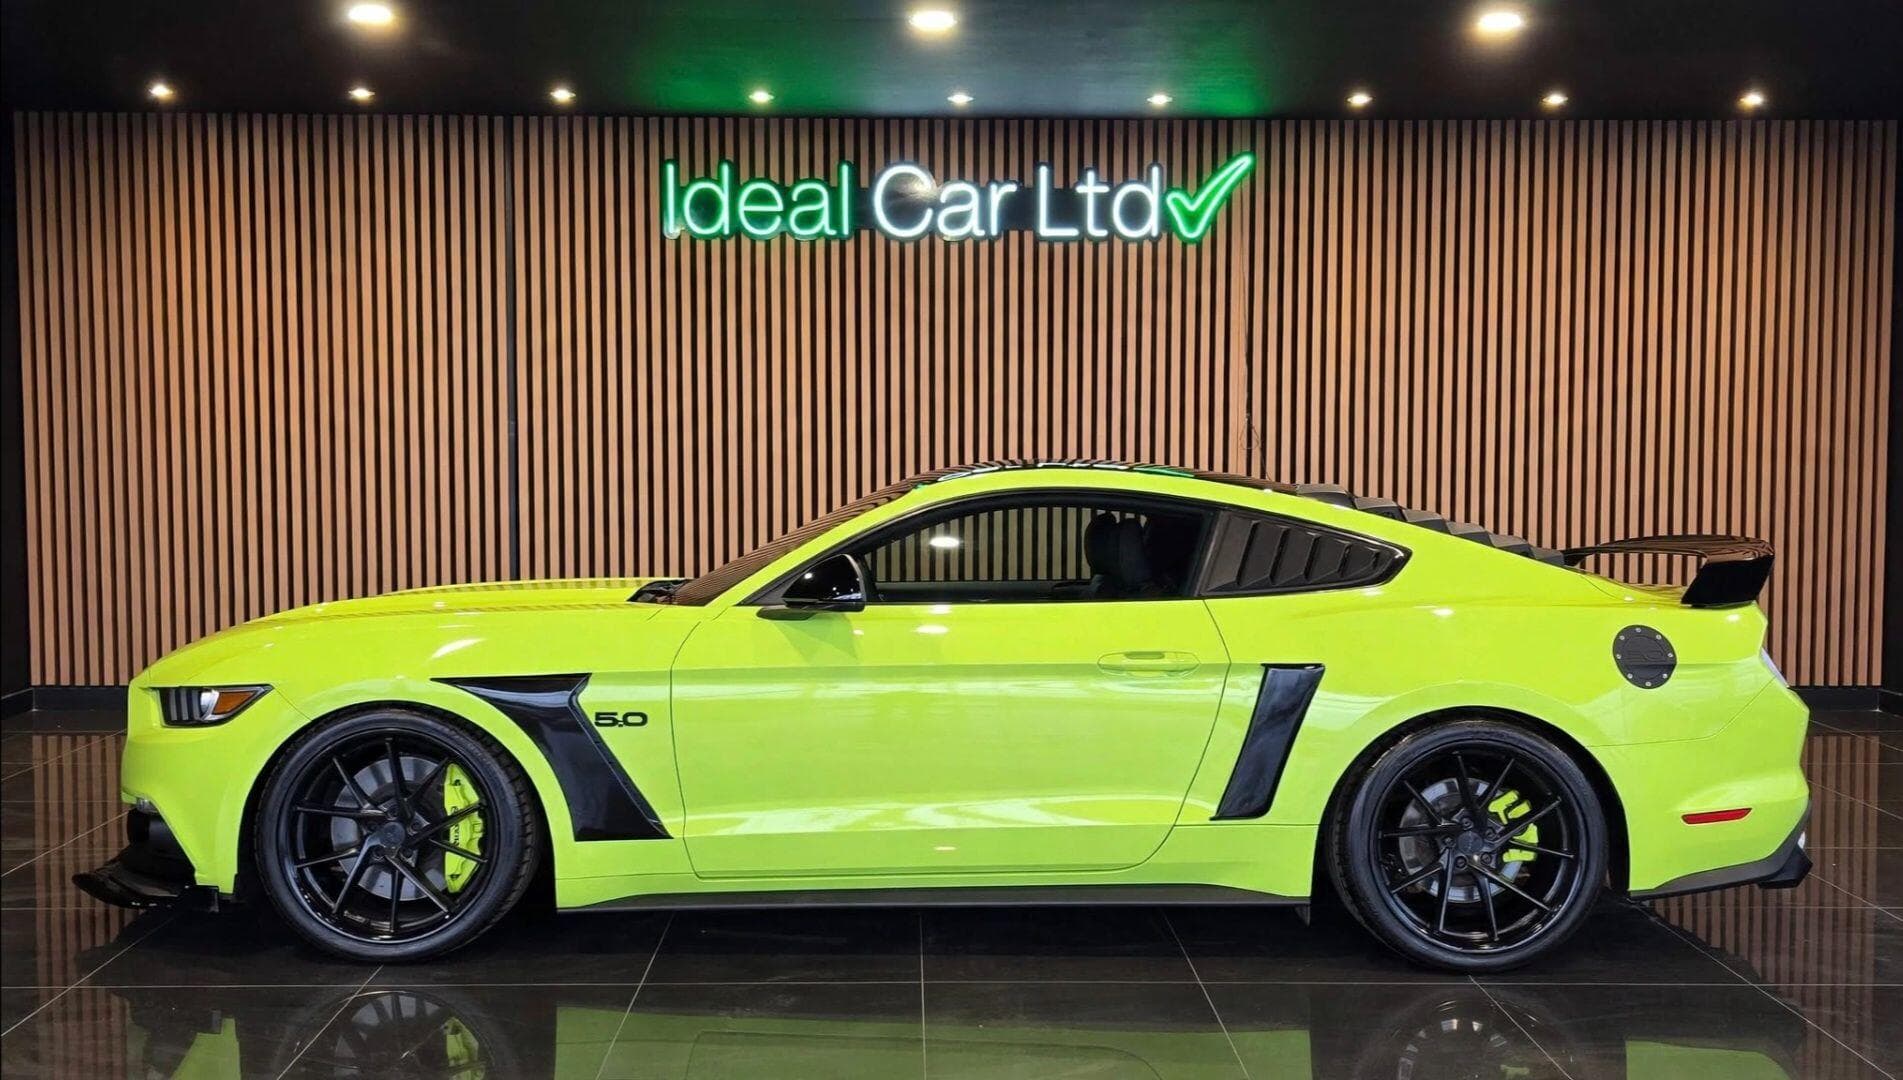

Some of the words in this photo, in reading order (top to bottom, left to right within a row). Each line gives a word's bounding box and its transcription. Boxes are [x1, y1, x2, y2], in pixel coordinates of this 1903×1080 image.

[664, 160, 850, 238] Ideal
[872, 163, 1018, 239] Car
[1036, 162, 1161, 239] Ltd
[594, 711, 648, 728] 5.0
